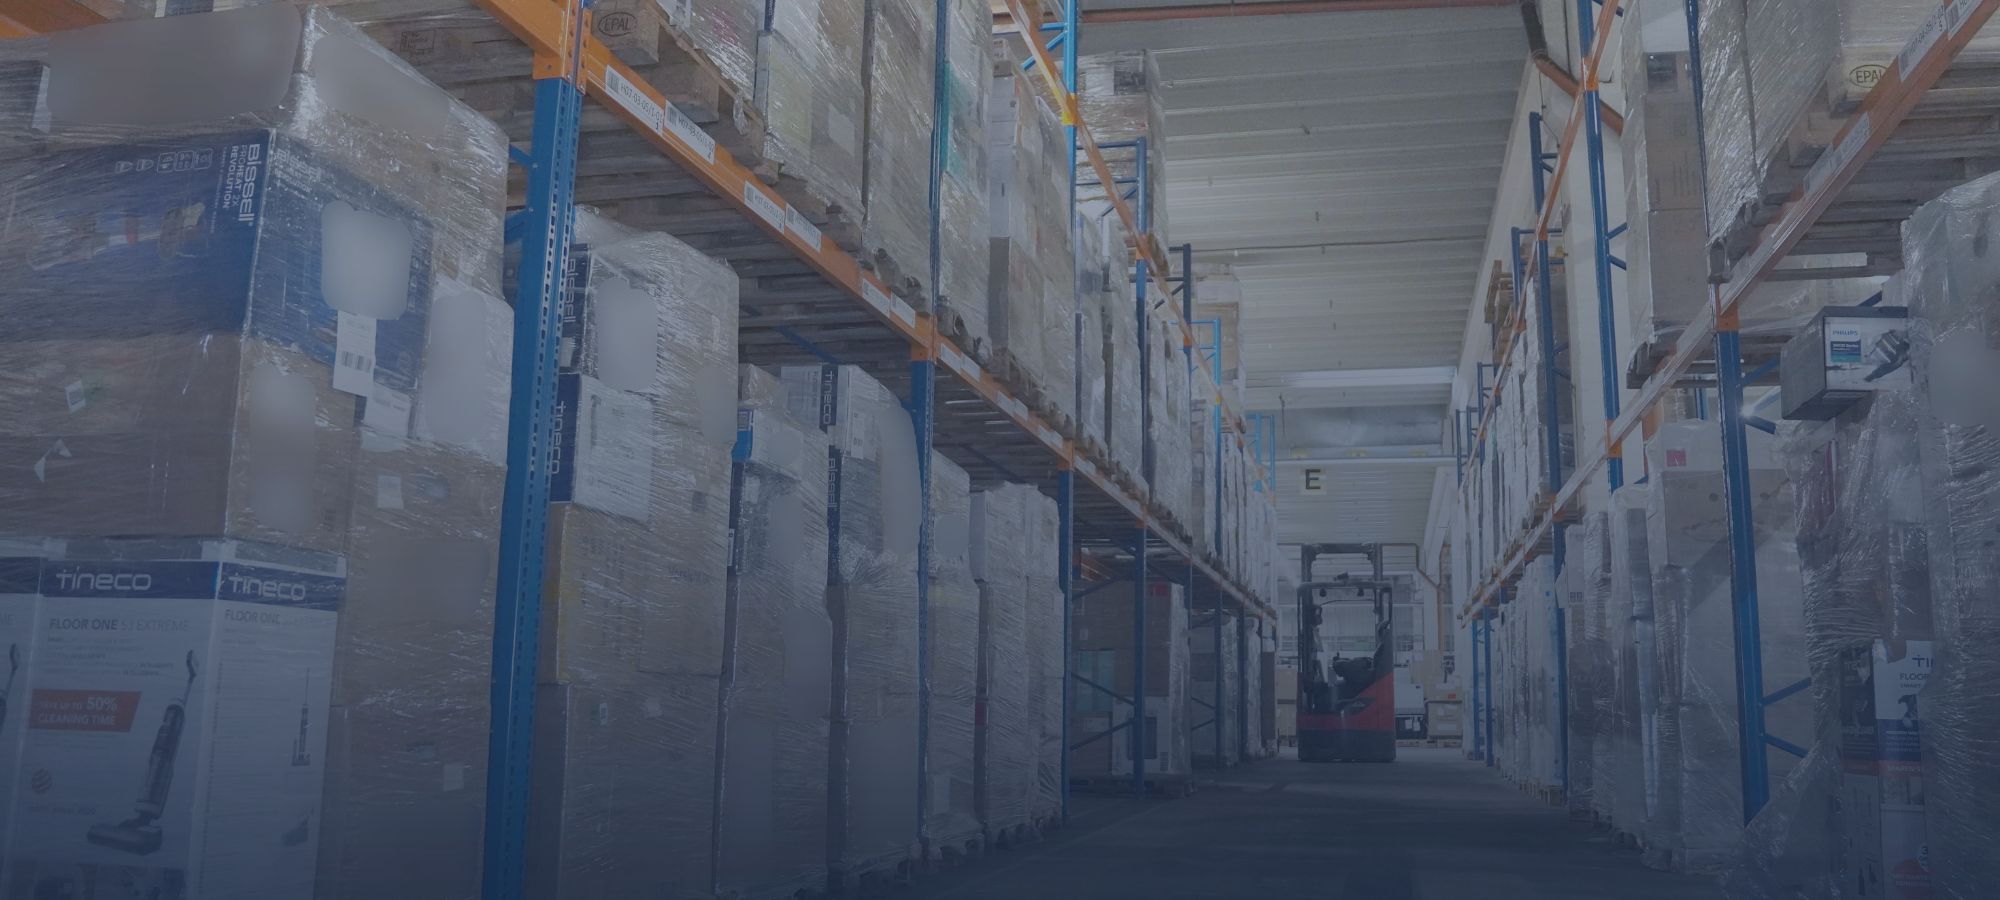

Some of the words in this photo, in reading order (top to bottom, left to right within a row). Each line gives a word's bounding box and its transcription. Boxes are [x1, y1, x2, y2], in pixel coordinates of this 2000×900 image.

[604, 16, 632, 31] EPAL
[222, 145, 240, 209] REVOLUTION
[1305, 468, 1322, 490] E
[49, 618, 88, 630] FLOOR
[91, 618, 119, 631] ONE
[225, 610, 258, 624] FLOOR
[86, 697, 118, 712] 50%
[39, 711, 90, 725] CLEANING
[91, 713, 117, 726] TIME
